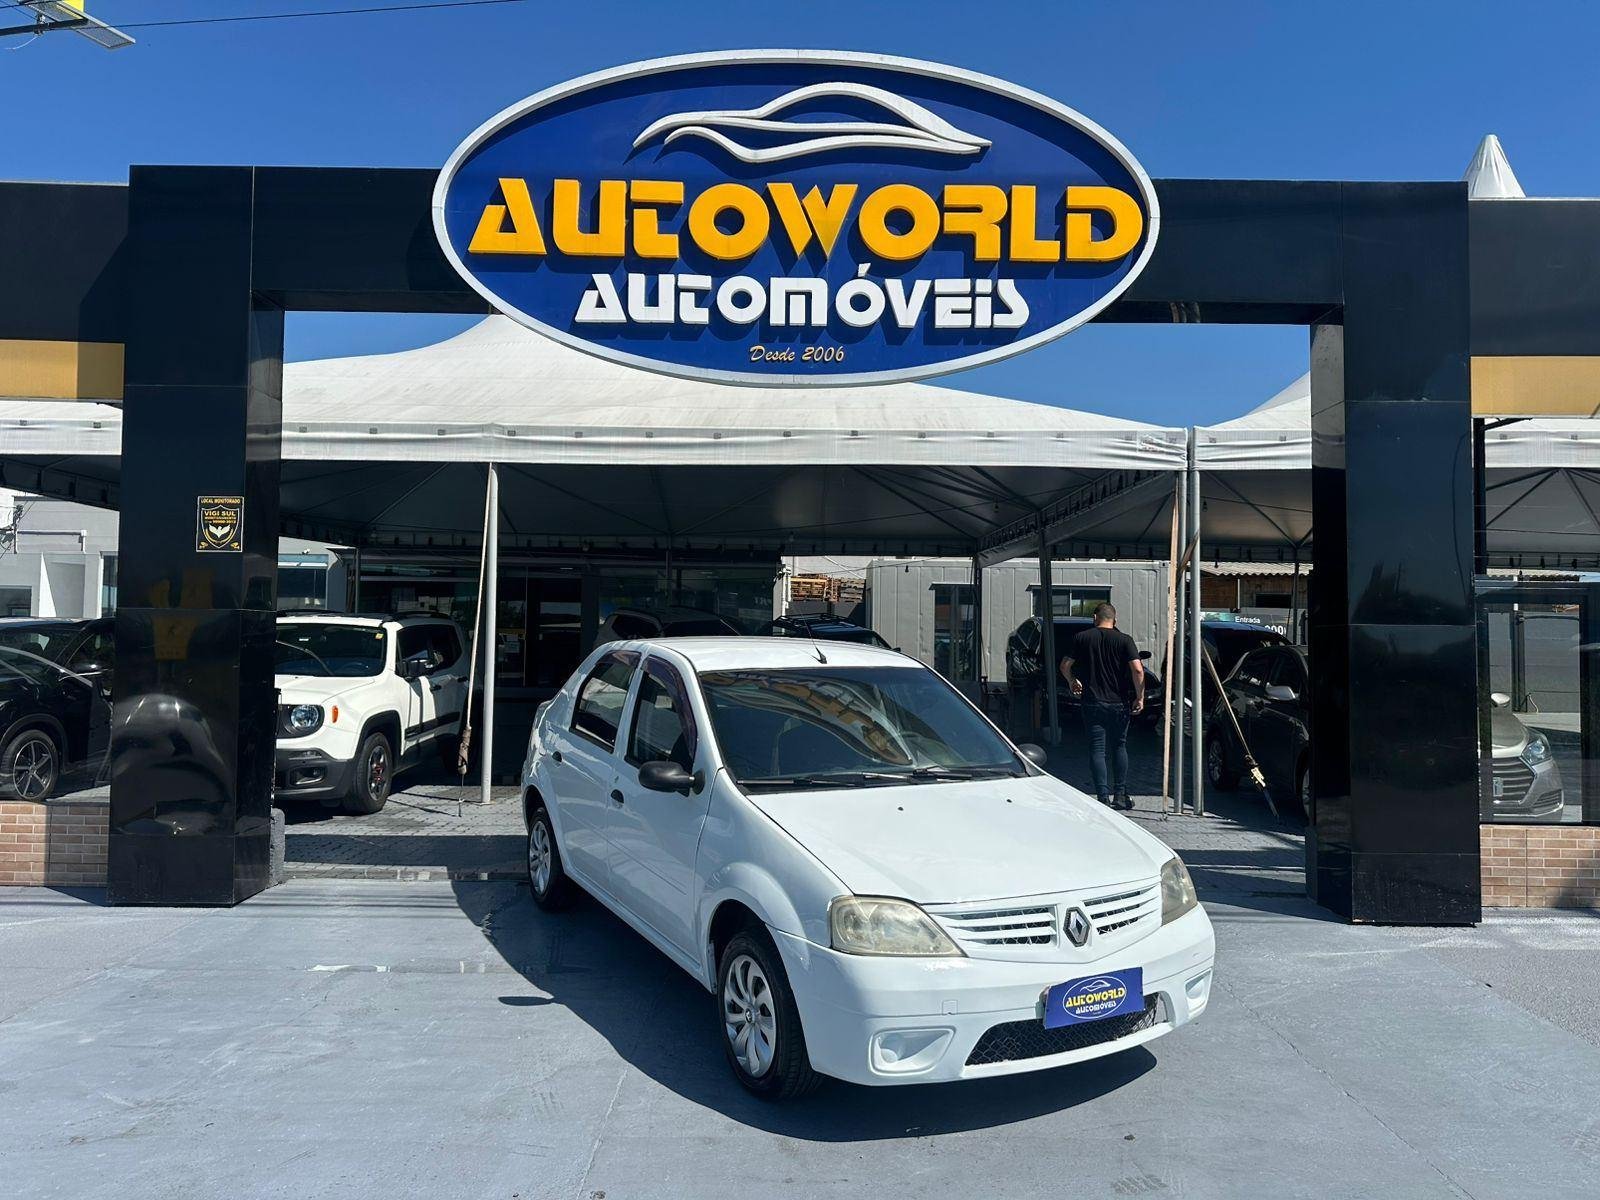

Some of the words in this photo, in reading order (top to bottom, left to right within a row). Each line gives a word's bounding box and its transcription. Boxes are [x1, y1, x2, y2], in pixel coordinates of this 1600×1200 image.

[468, 178, 1144, 262] AUTOWORLD
[574, 263, 1030, 329] AUTOMÓVEIS
[749, 345, 796, 362] Desde
[801, 346, 845, 362] 2006
[1235, 616, 1261, 624] Entrada
[1066, 987, 1125, 1007] AUTOWORLD
